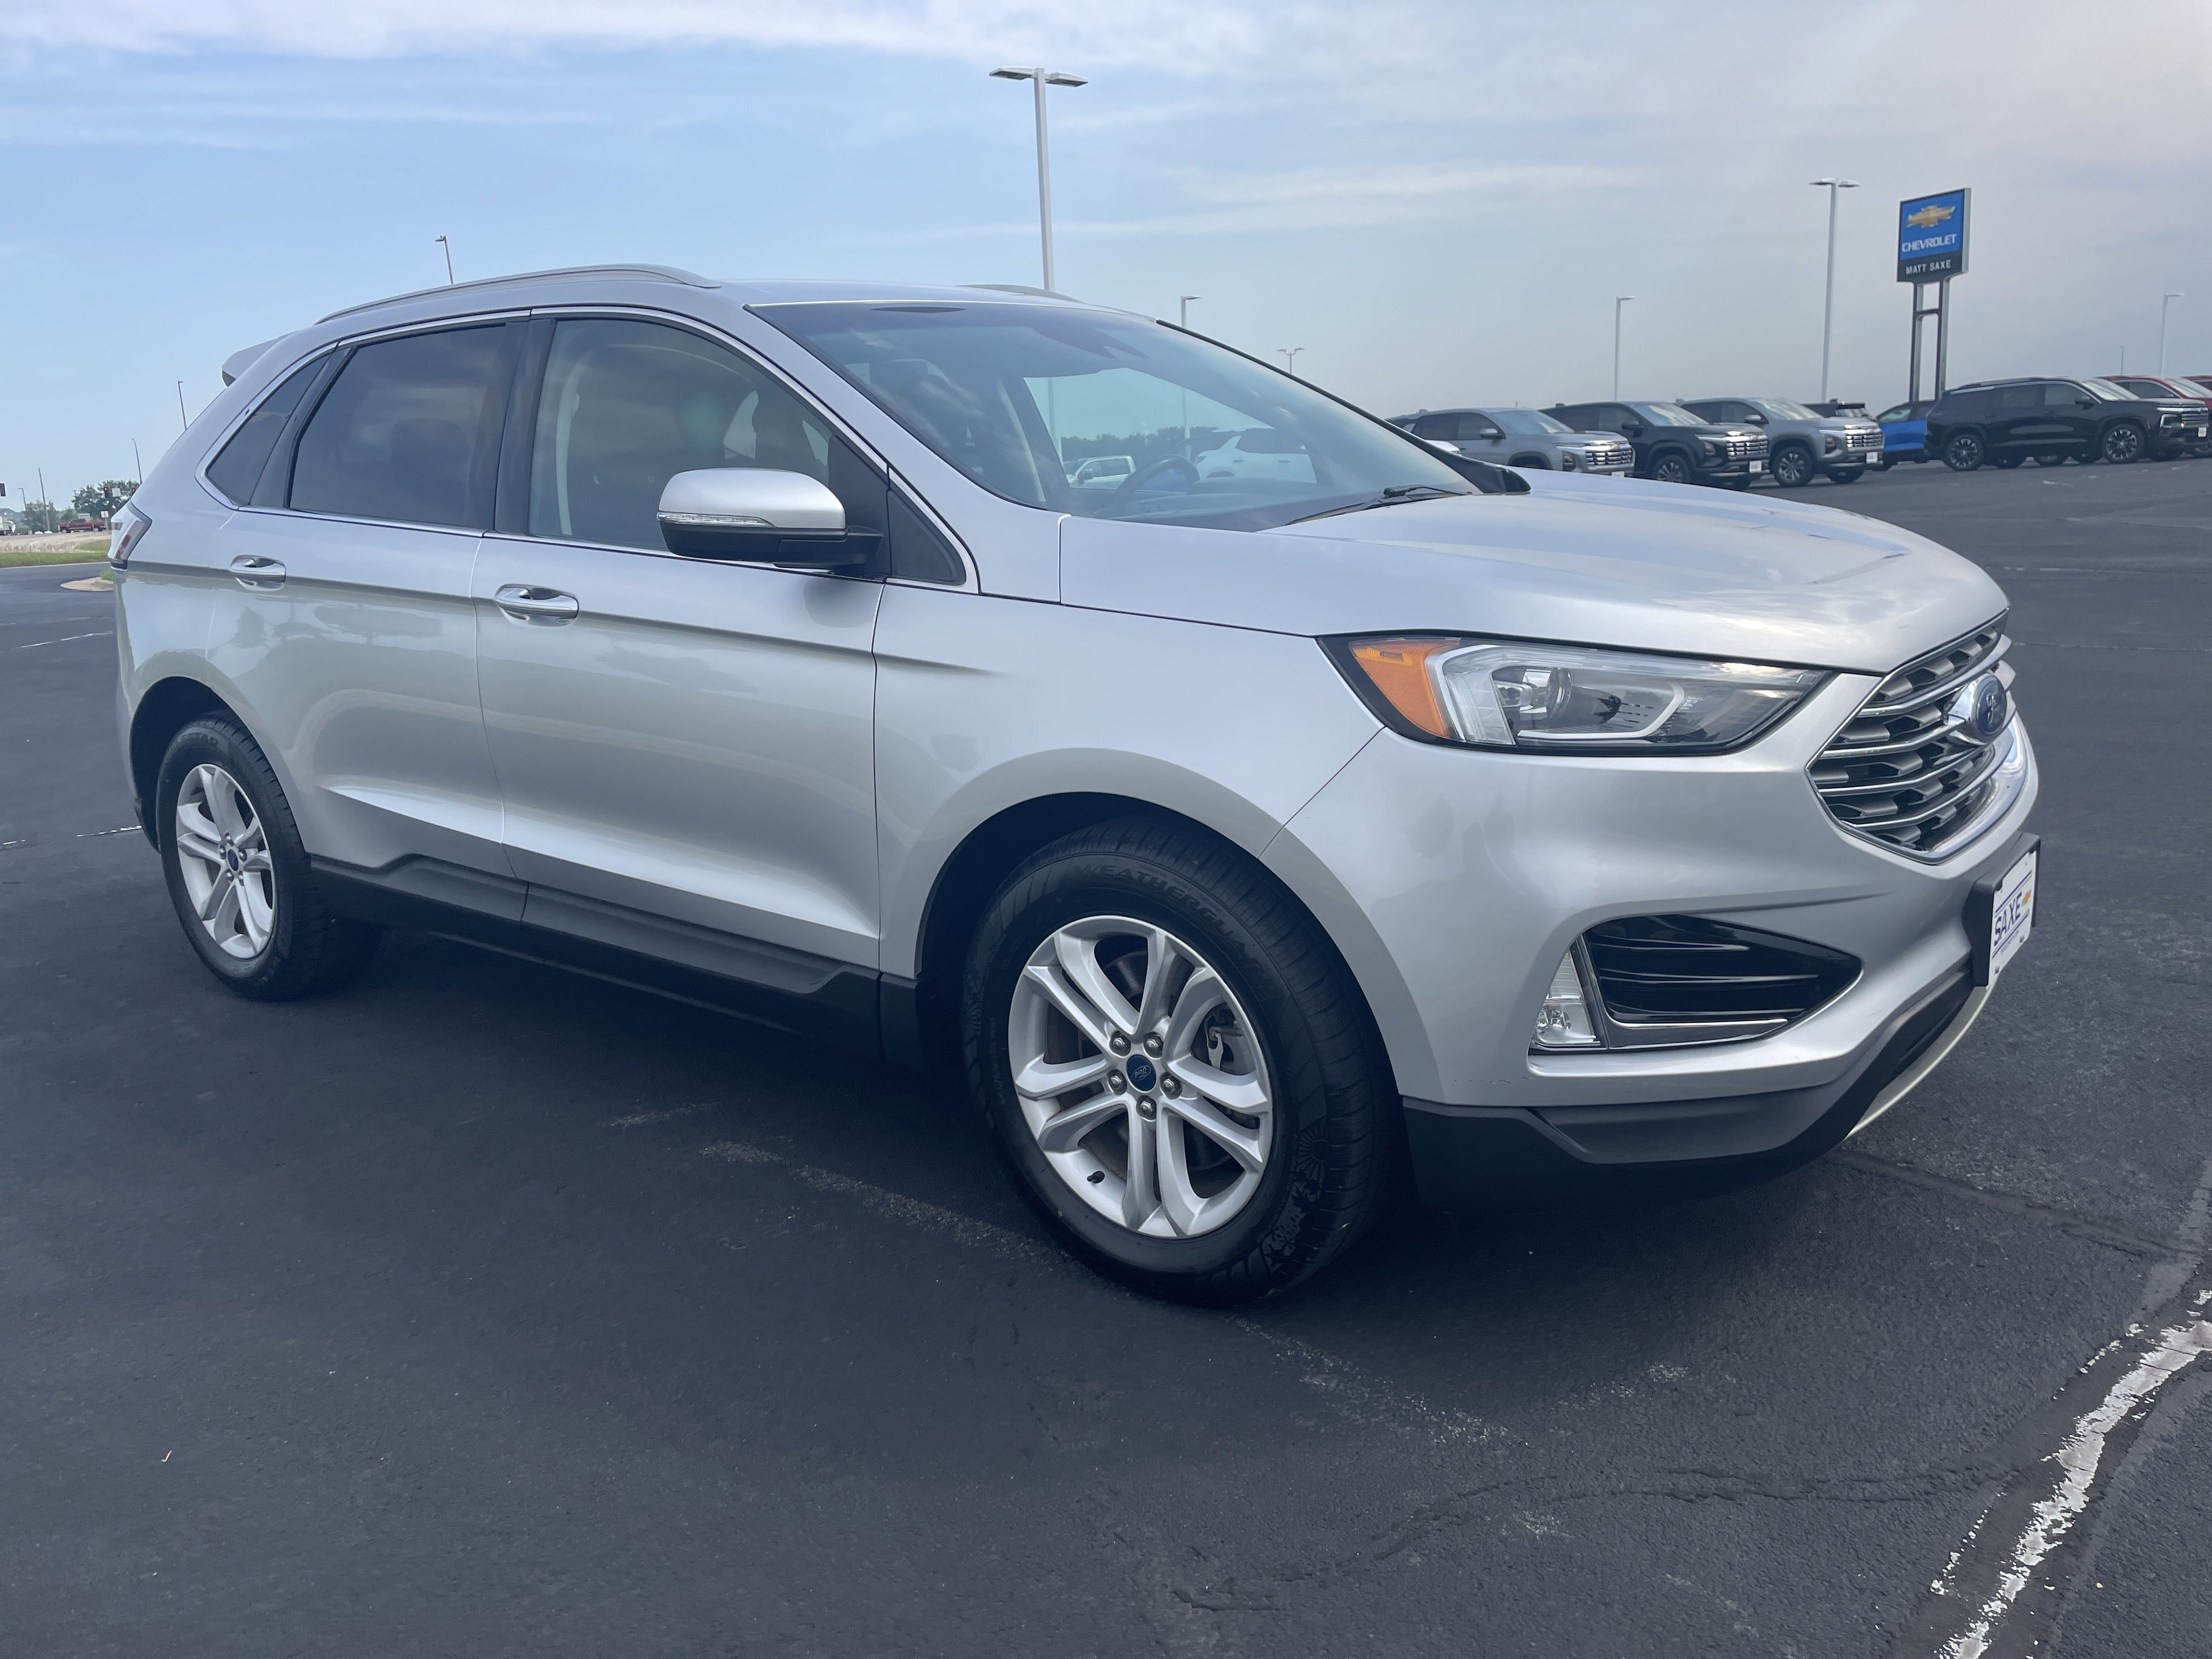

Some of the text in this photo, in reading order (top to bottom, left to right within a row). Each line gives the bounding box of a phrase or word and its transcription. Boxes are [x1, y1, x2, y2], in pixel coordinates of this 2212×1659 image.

[1902, 234, 1957, 252] CHEVROLET
[1906, 260, 1951, 275] MATT SAXE
[1994, 891, 2022, 946] SAXE
